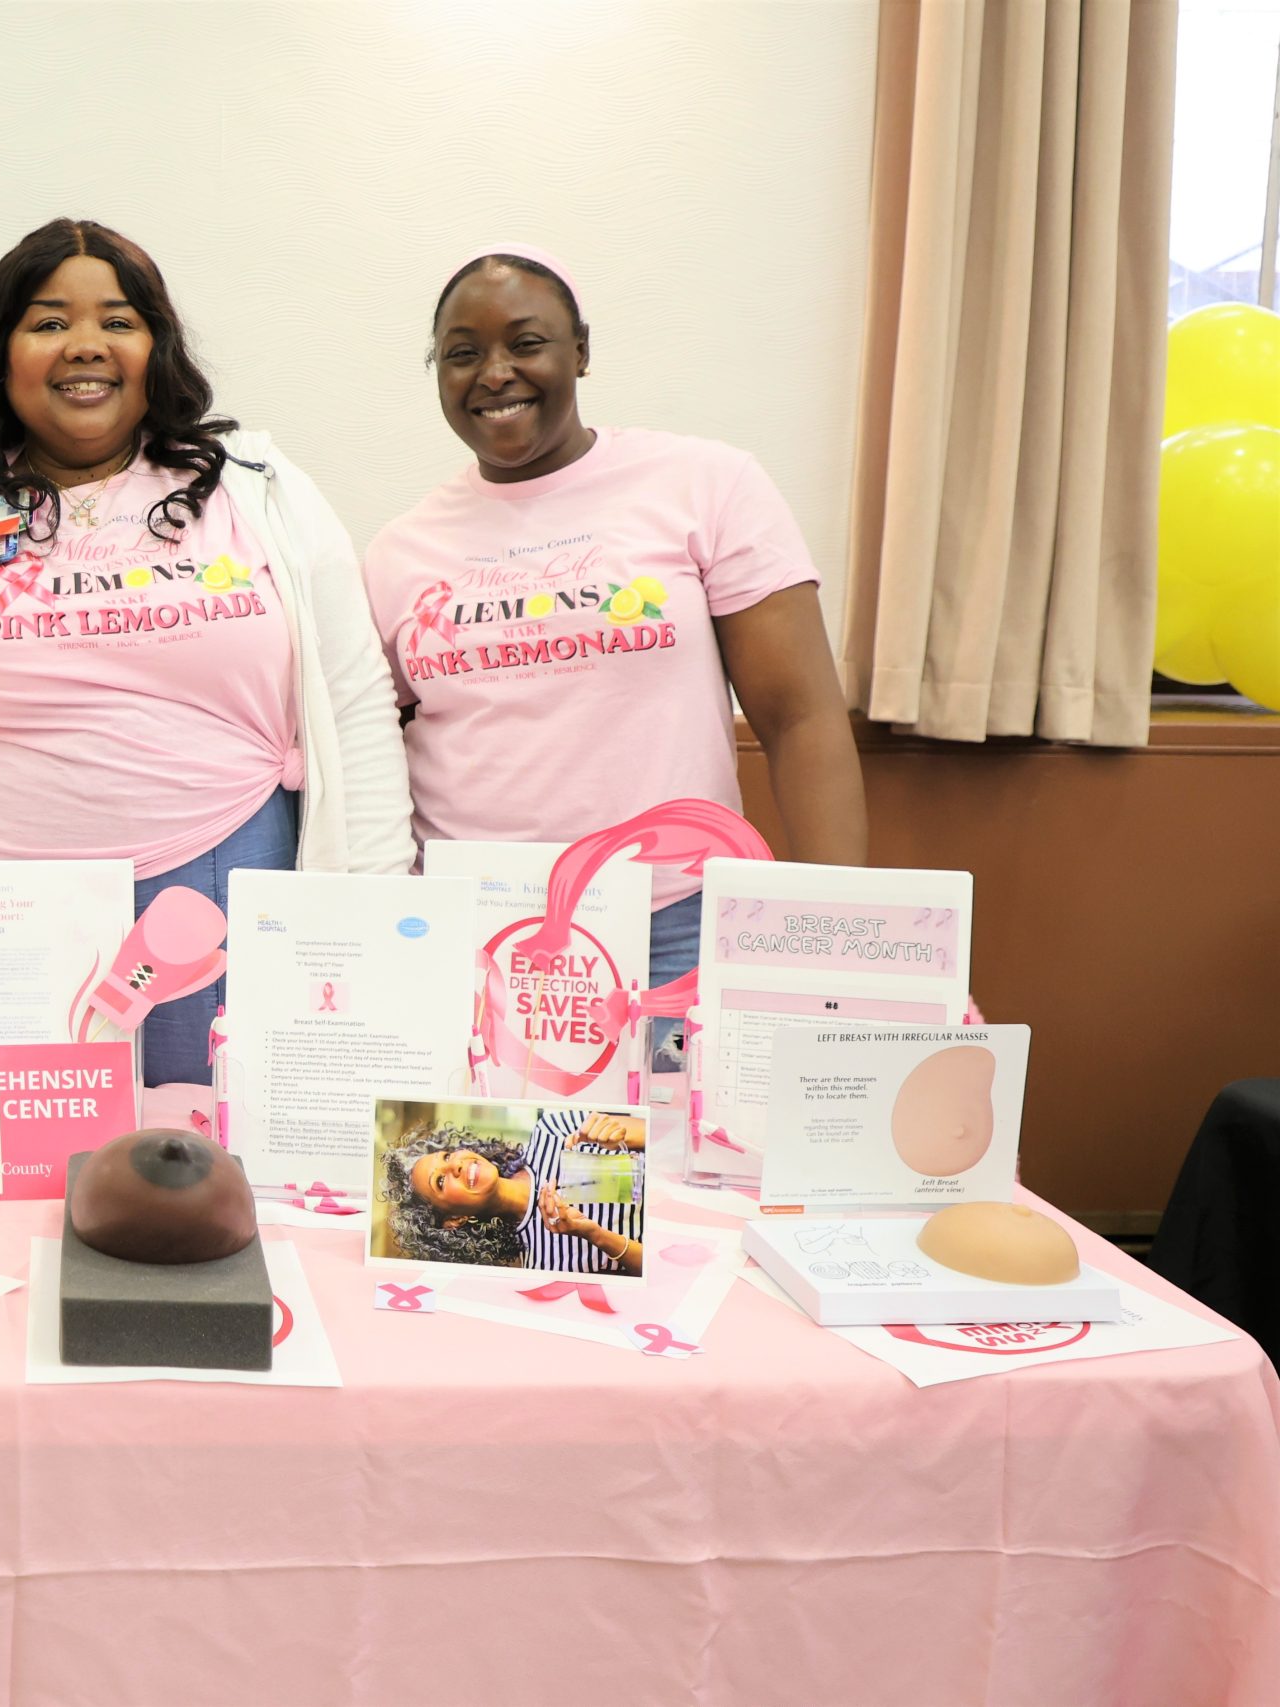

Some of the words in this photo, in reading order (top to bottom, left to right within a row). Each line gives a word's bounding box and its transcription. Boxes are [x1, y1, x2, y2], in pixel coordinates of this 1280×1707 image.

[51, 533, 116, 561] When
[509, 546, 543, 559] Kings
[547, 534, 593, 550] County
[52, 558, 195, 596] LEMONS
[457, 567, 528, 589] When
[539, 544, 605, 580] Life
[78, 591, 266, 636] LEMONADE
[453, 584, 600, 625] LEMONS
[57, 641, 99, 651] STRENGTH
[158, 631, 202, 645] RESILIENCE
[503, 624, 546, 640] MAKE
[406, 648, 473, 682] PINK
[476, 622, 677, 671] LEMONADE
[462, 675, 500, 686] STRENGTH
[515, 671, 537, 680] HOPE
[553, 663, 597, 676] RESILIENCE
[523, 883, 548, 895] Kin
[10, 899, 35, 909] Your
[490, 899, 503, 907] You
[505, 900, 536, 909] Examine
[580, 904, 608, 913] Today?
[784, 915, 886, 938] BREAST
[738, 932, 833, 955] CANCER
[841, 939, 932, 963] MONTH
[509, 976, 599, 994] DETECTION
[825, 1001, 839, 1010] #8
[525, 1017, 605, 1045] LIVES
[817, 1033, 837, 1042] LEFT
[839, 1033, 872, 1042] BREAST
[874, 1033, 899, 1041] WITH
[901, 1033, 952, 1041] IRREGULAR
[954, 1032, 989, 1041] MASSES
[3, 1098, 99, 1119] CENTER
[1, 1162, 53, 1178] County
